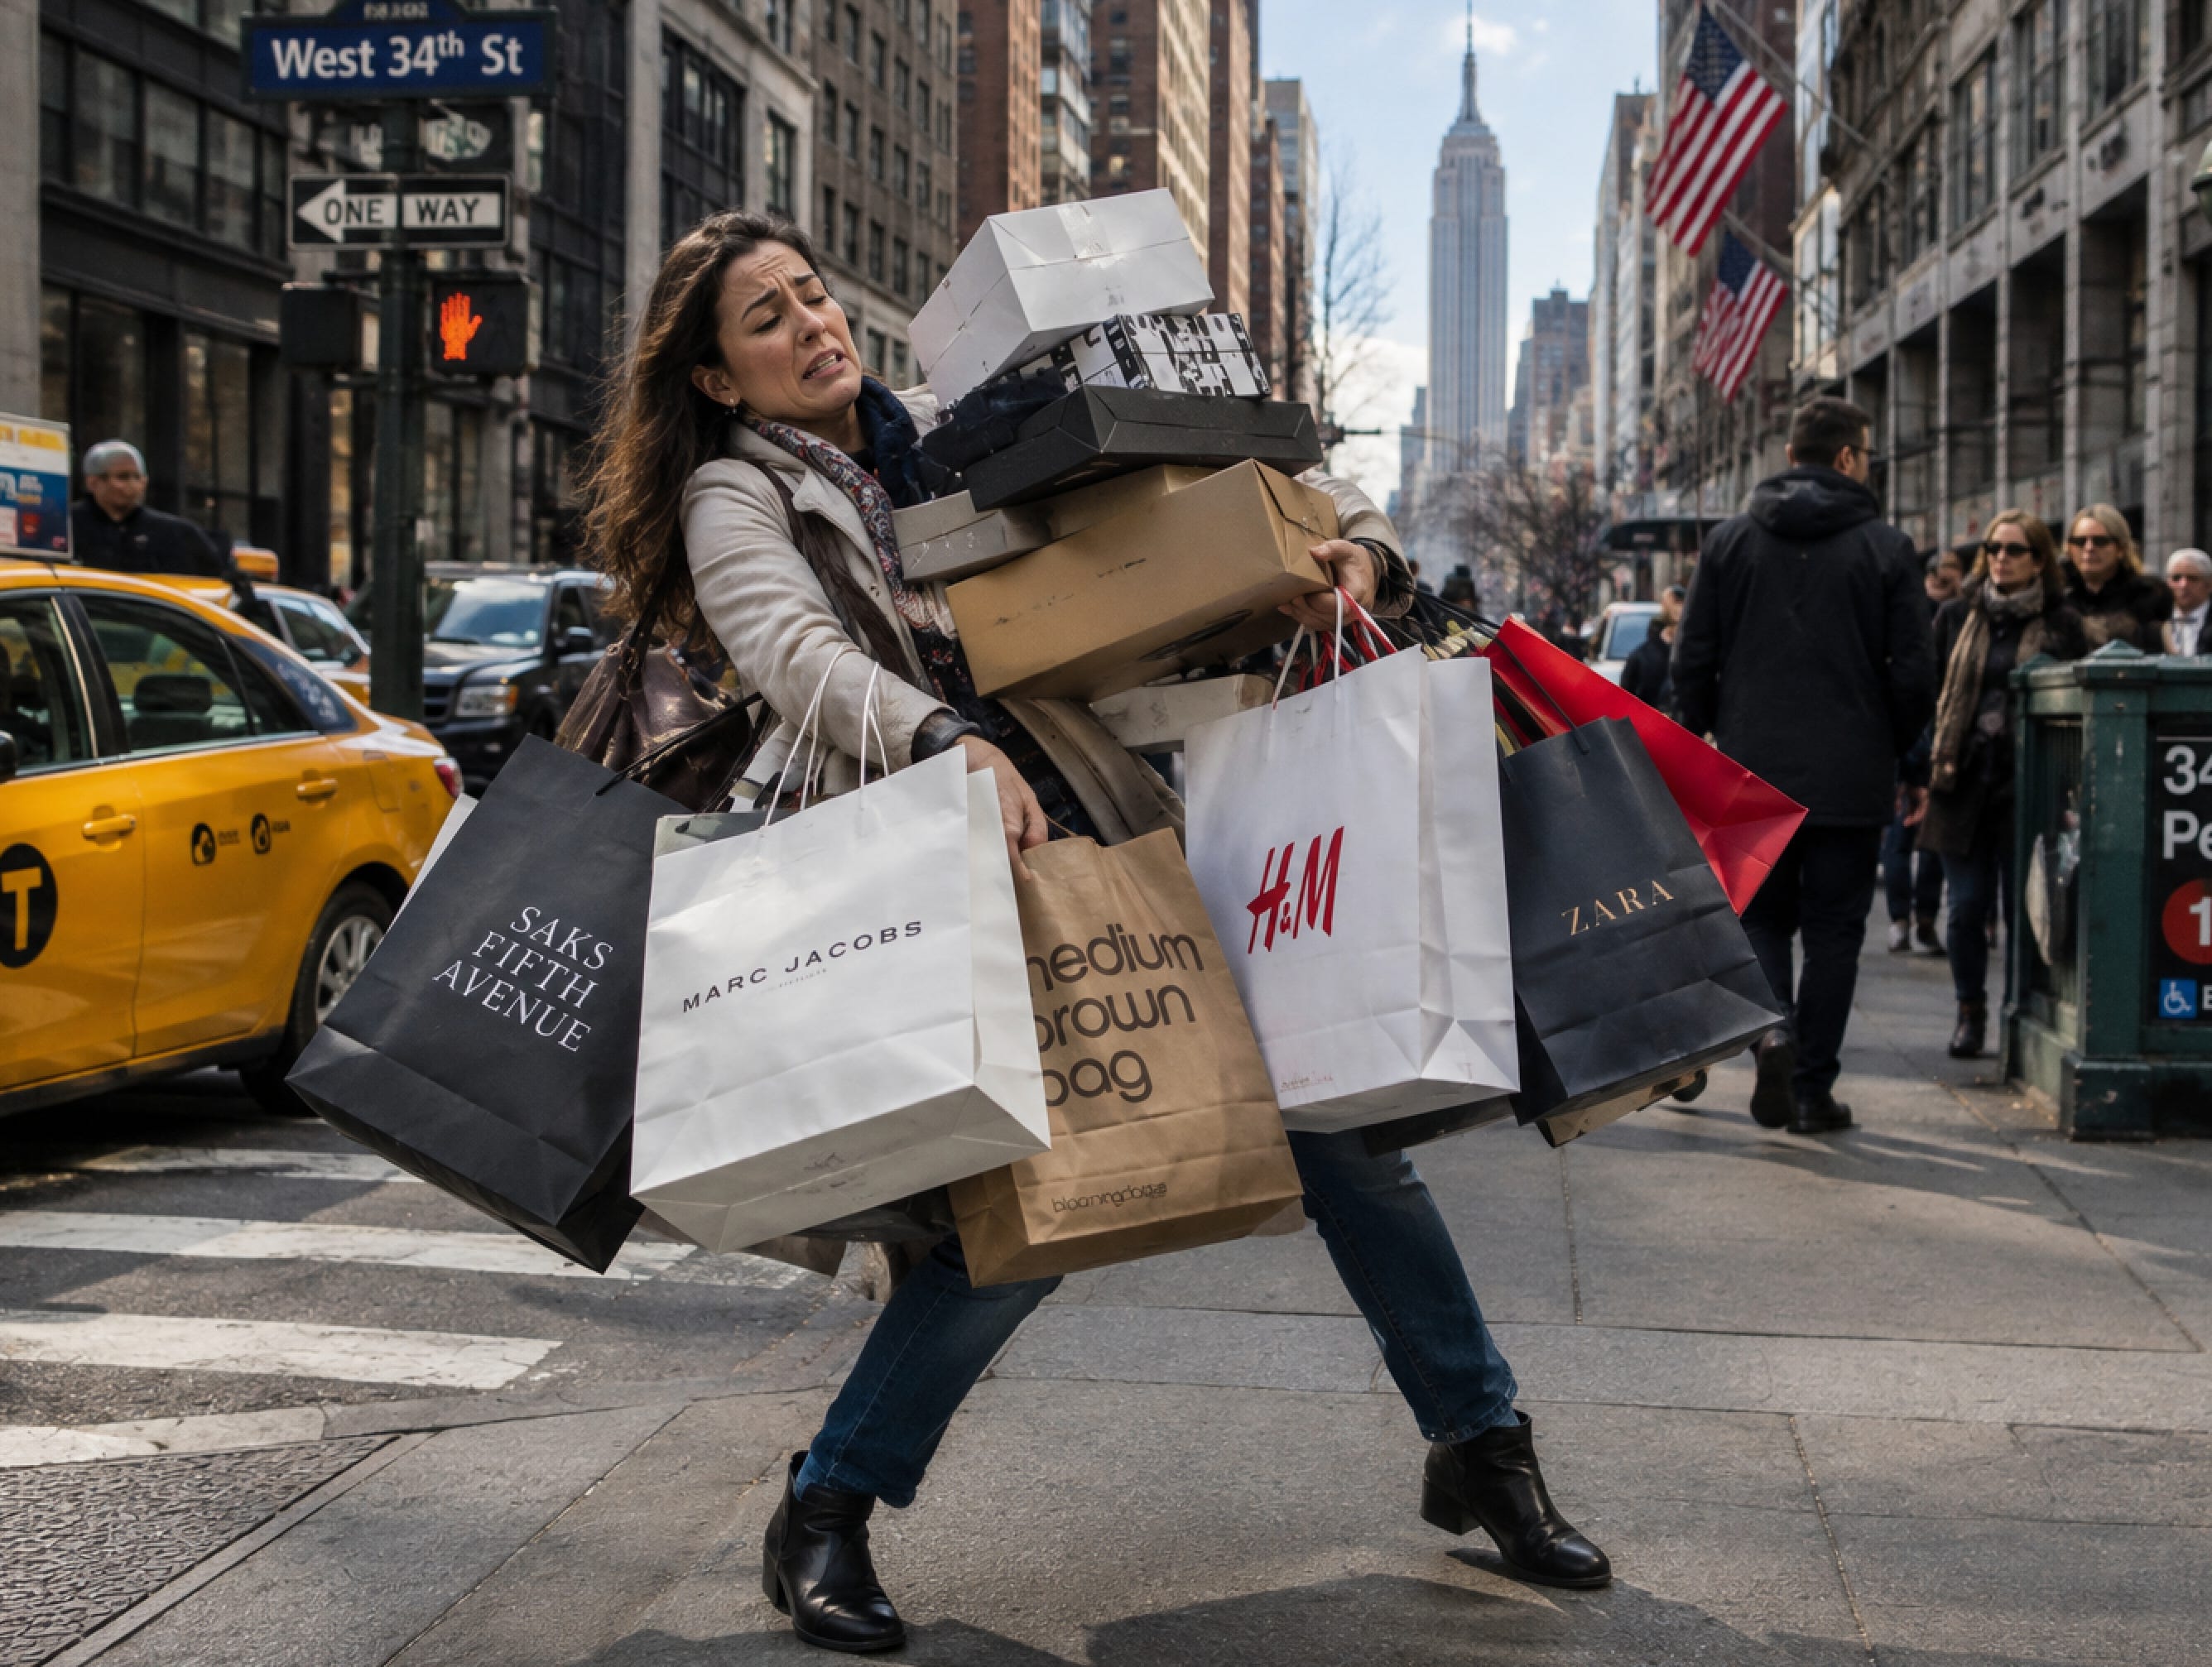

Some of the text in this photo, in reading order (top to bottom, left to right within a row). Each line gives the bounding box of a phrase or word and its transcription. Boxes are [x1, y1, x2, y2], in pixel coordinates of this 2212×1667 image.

[271, 31, 523, 79] West 34th St
[324, 199, 480, 225] ONE WAY
[1, 867, 42, 952] T
[1246, 826, 1345, 954] H&M
[1561, 880, 1674, 936] ZARA
[2188, 896, 2211, 946] 1
[471, 930, 599, 1009] FIFTH
[509, 906, 613, 970] SAKS
[683, 968, 767, 1013] MARC
[784, 920, 922, 973] JACOBS
[431, 959, 592, 1052] AVENUE
